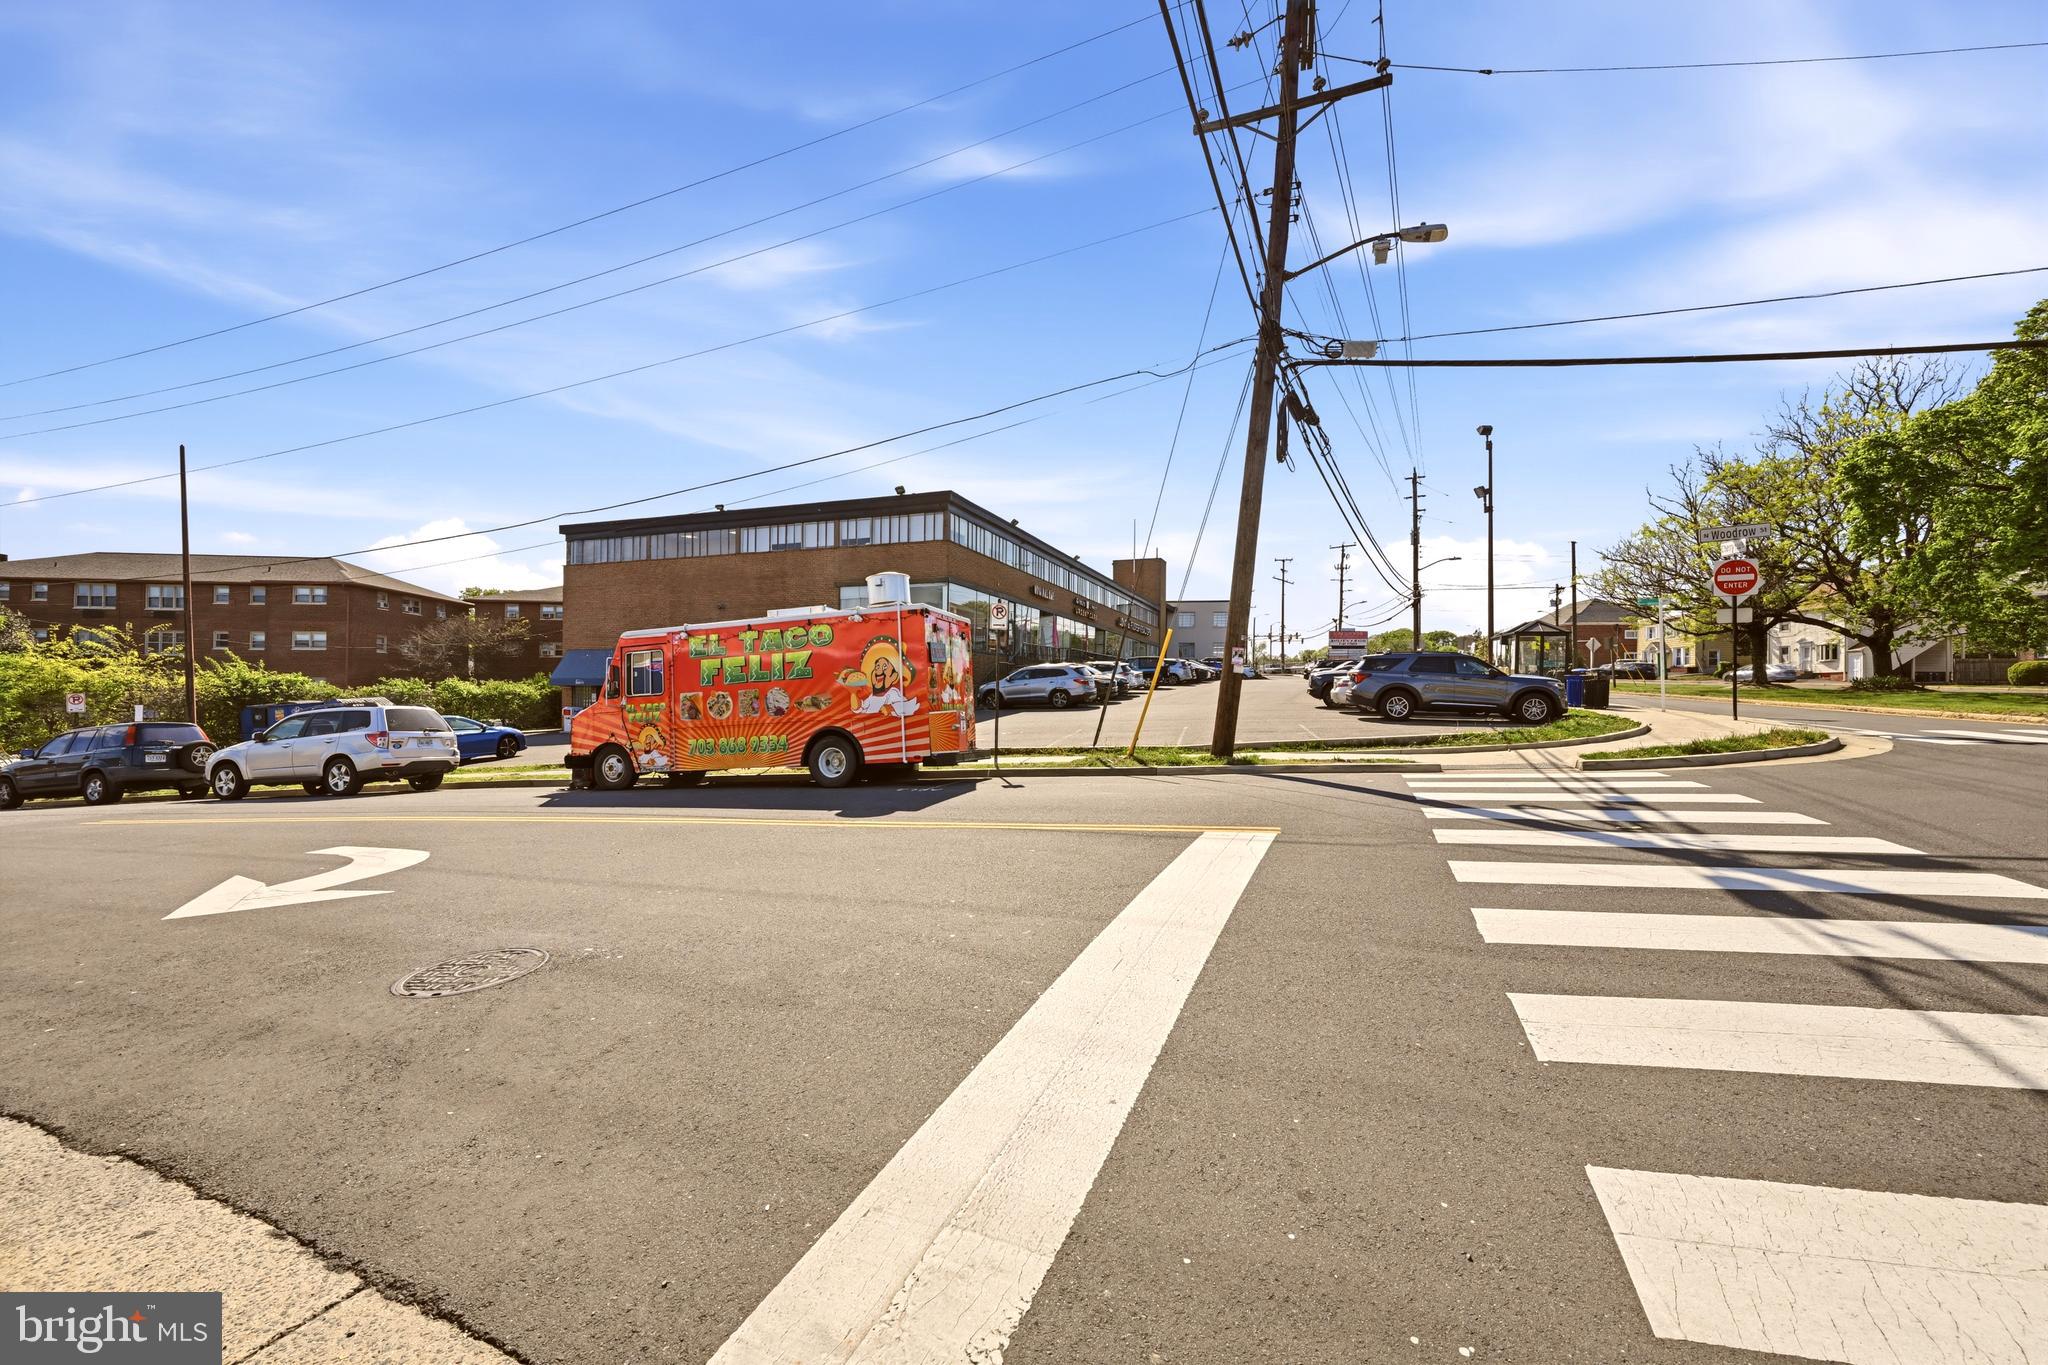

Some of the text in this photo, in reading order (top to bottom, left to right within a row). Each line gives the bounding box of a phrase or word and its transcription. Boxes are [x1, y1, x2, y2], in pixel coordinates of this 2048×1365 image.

[1711, 528, 1757, 540] Woodrow
[1723, 581, 1748, 589] ENTER
[688, 624, 833, 658] EL TACO
[700, 650, 813, 686] FELIZ
[687, 734, 789, 756] 703 868 9334
